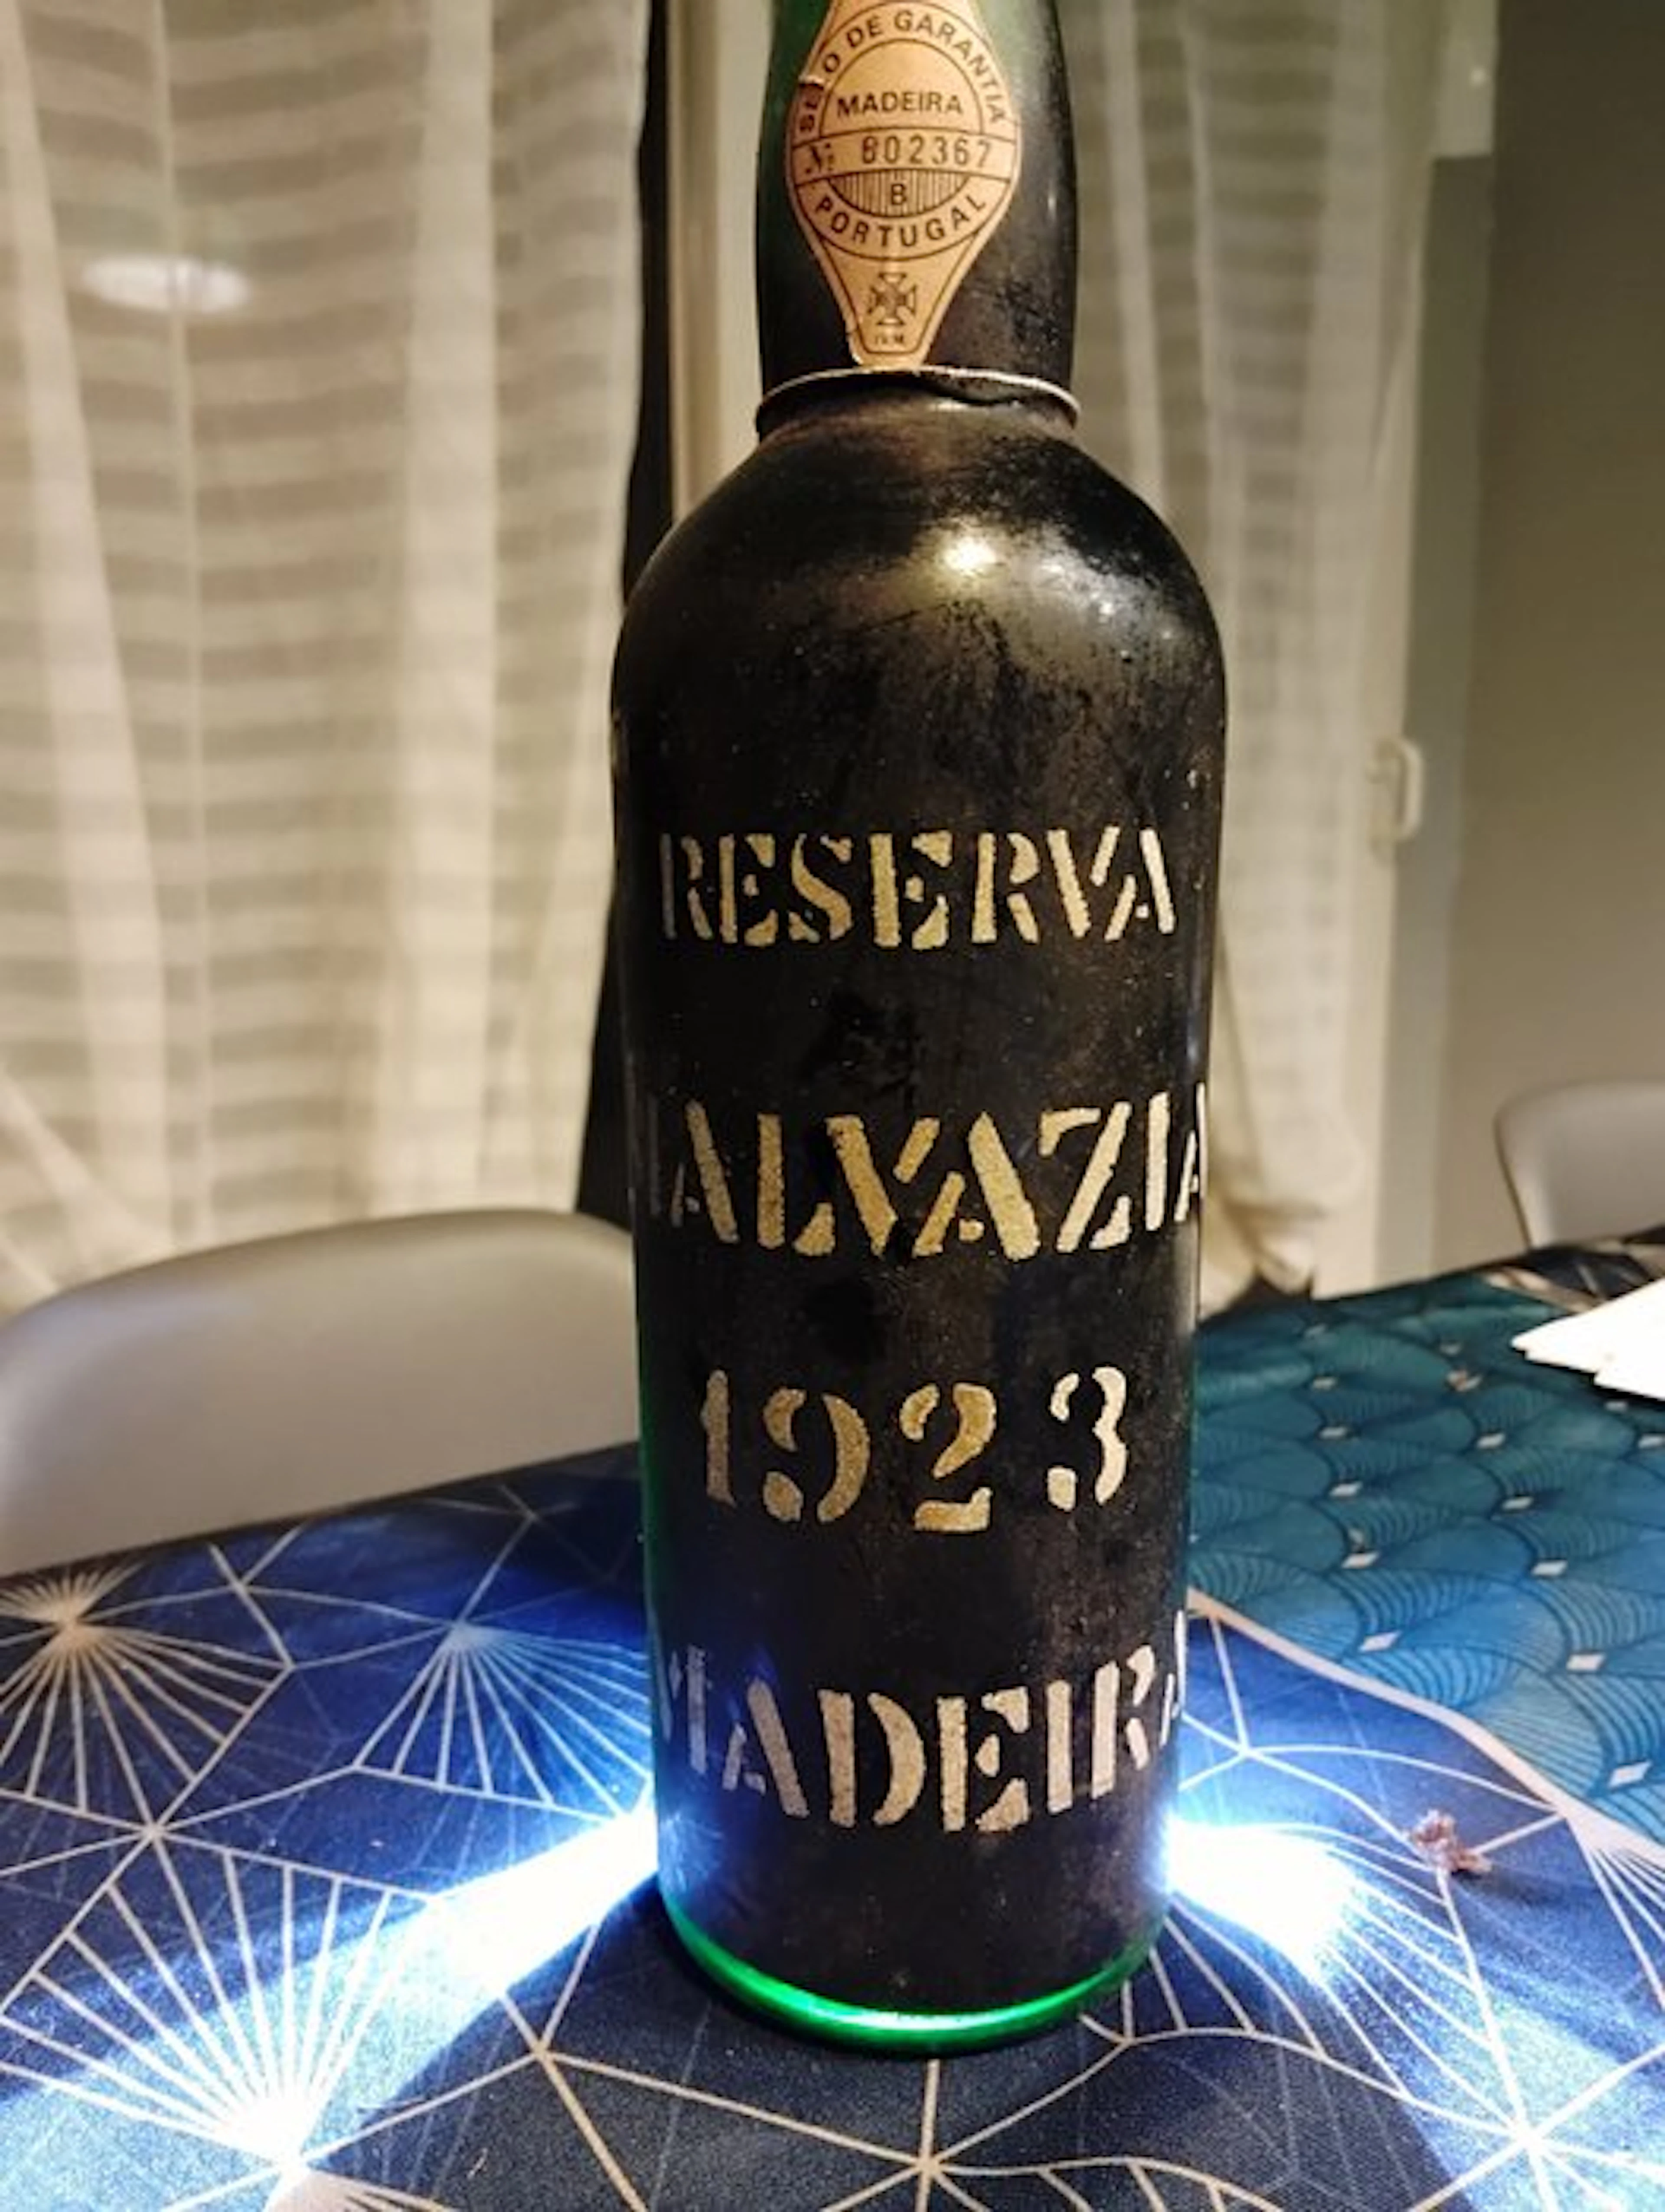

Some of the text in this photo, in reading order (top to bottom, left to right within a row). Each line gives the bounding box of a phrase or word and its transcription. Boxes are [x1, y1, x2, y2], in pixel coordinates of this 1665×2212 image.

[837, 89, 963, 119] MADEIRA
[846, 15, 883, 47] DE
[894, 10, 1007, 124] GARANTIA
[815, 194, 986, 248] PORTUGAL
[890, 183, 907, 205] B
[660, 825, 1176, 951] RESERVA
[650, 1081, 1208, 1261] ALVAZIA
[700, 1366, 1129, 1532] 1923
